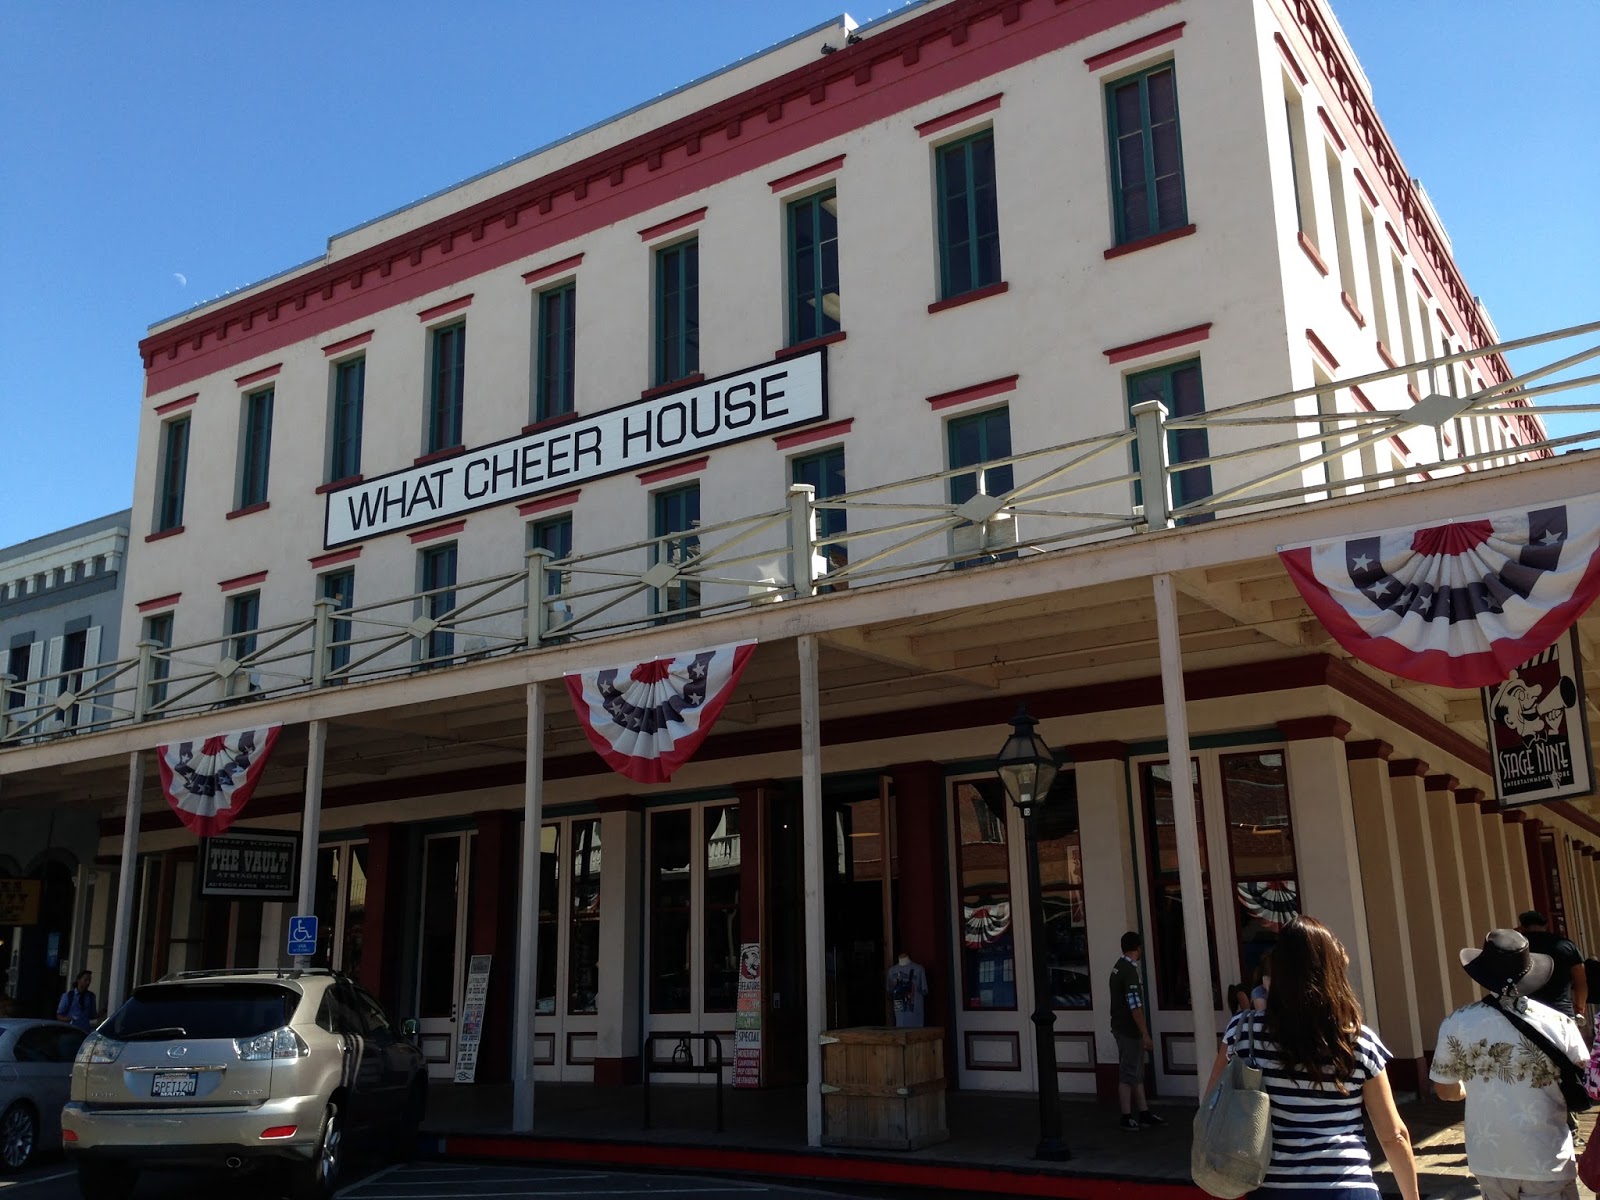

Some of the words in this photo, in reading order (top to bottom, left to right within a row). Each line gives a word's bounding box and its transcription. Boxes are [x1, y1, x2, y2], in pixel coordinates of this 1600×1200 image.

[348, 468, 453, 531] WHAT
[464, 426, 602, 501] CHEER
[622, 371, 789, 458] HOUSE
[1499, 750, 1534, 779] STAGE
[1535, 742, 1568, 774] NINE
[211, 848, 240, 871] THE
[244, 850, 289, 873] VAULT
[738, 1031, 759, 1042] SPECIAL
